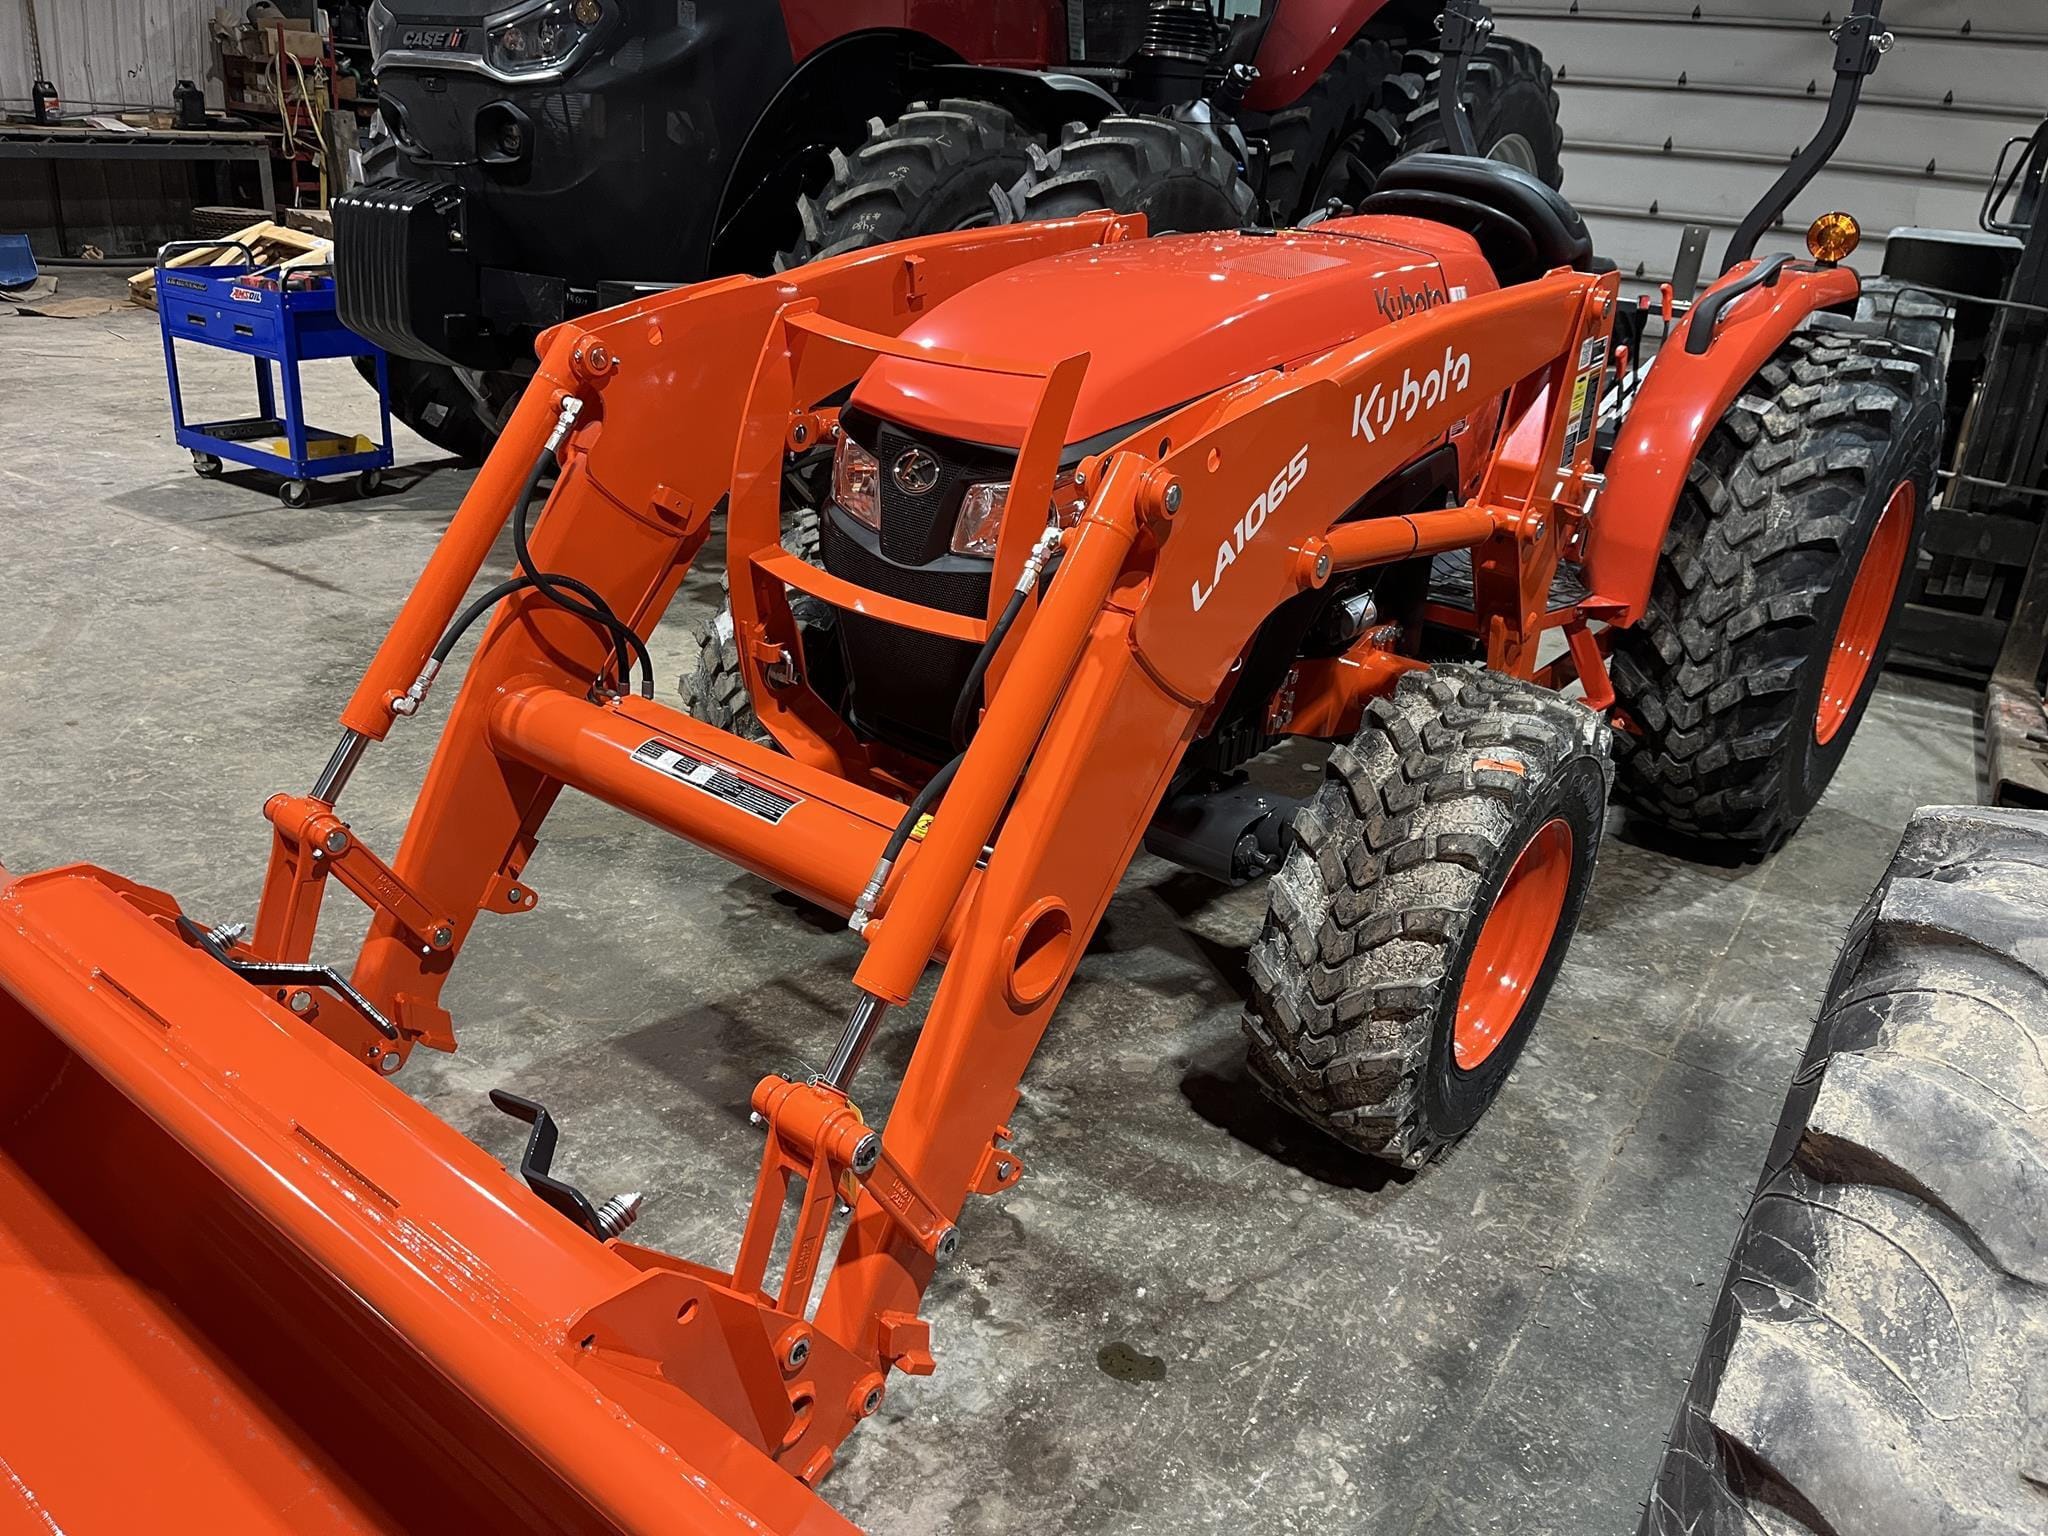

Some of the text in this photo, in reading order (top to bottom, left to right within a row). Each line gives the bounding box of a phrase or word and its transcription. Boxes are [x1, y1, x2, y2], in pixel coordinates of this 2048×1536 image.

[402, 31, 445, 46] CASE
[232, 287, 261, 302] AMSOIL
[1373, 280, 1444, 322] Kubota
[1351, 345, 1471, 443] Kubota
[1191, 443, 1309, 612] LA1065
